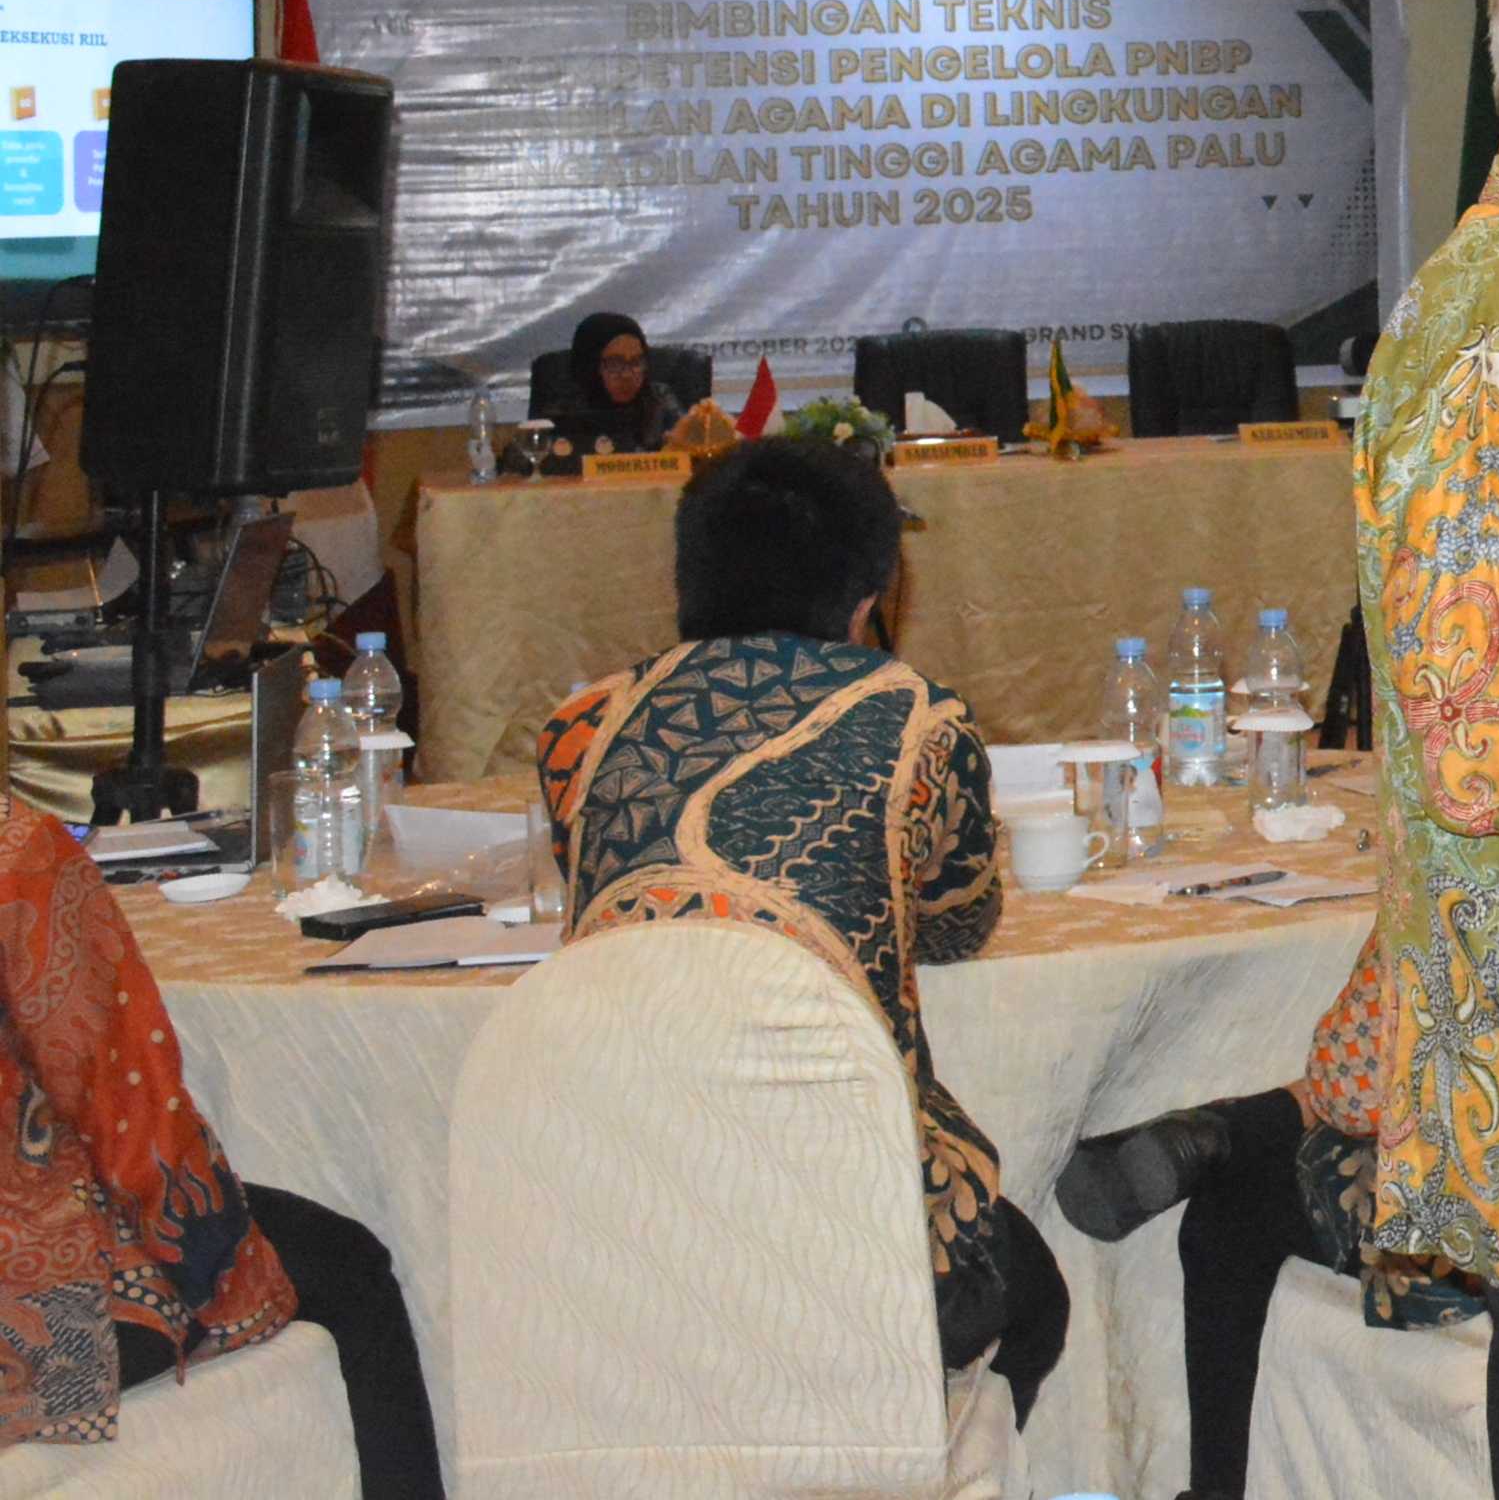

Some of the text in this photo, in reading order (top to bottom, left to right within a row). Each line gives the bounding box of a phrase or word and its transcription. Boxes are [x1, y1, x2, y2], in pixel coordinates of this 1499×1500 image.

[0, 30, 109, 47] EKSEKUSI RIIL
[829, 42, 1116, 85] PENGELOLA
[1126, 38, 1253, 77] PNBP
[722, 94, 911, 135] AGAMA
[919, 92, 971, 129] DI
[983, 83, 1303, 126] LINGKUNGAN
[790, 140, 964, 182] TINGGI
[976, 134, 1157, 178] AGAMA
[1166, 131, 1288, 170] PALU
[728, 185, 1035, 232] TAHUN 2025
[1024, 322, 1105, 344] GRAND
